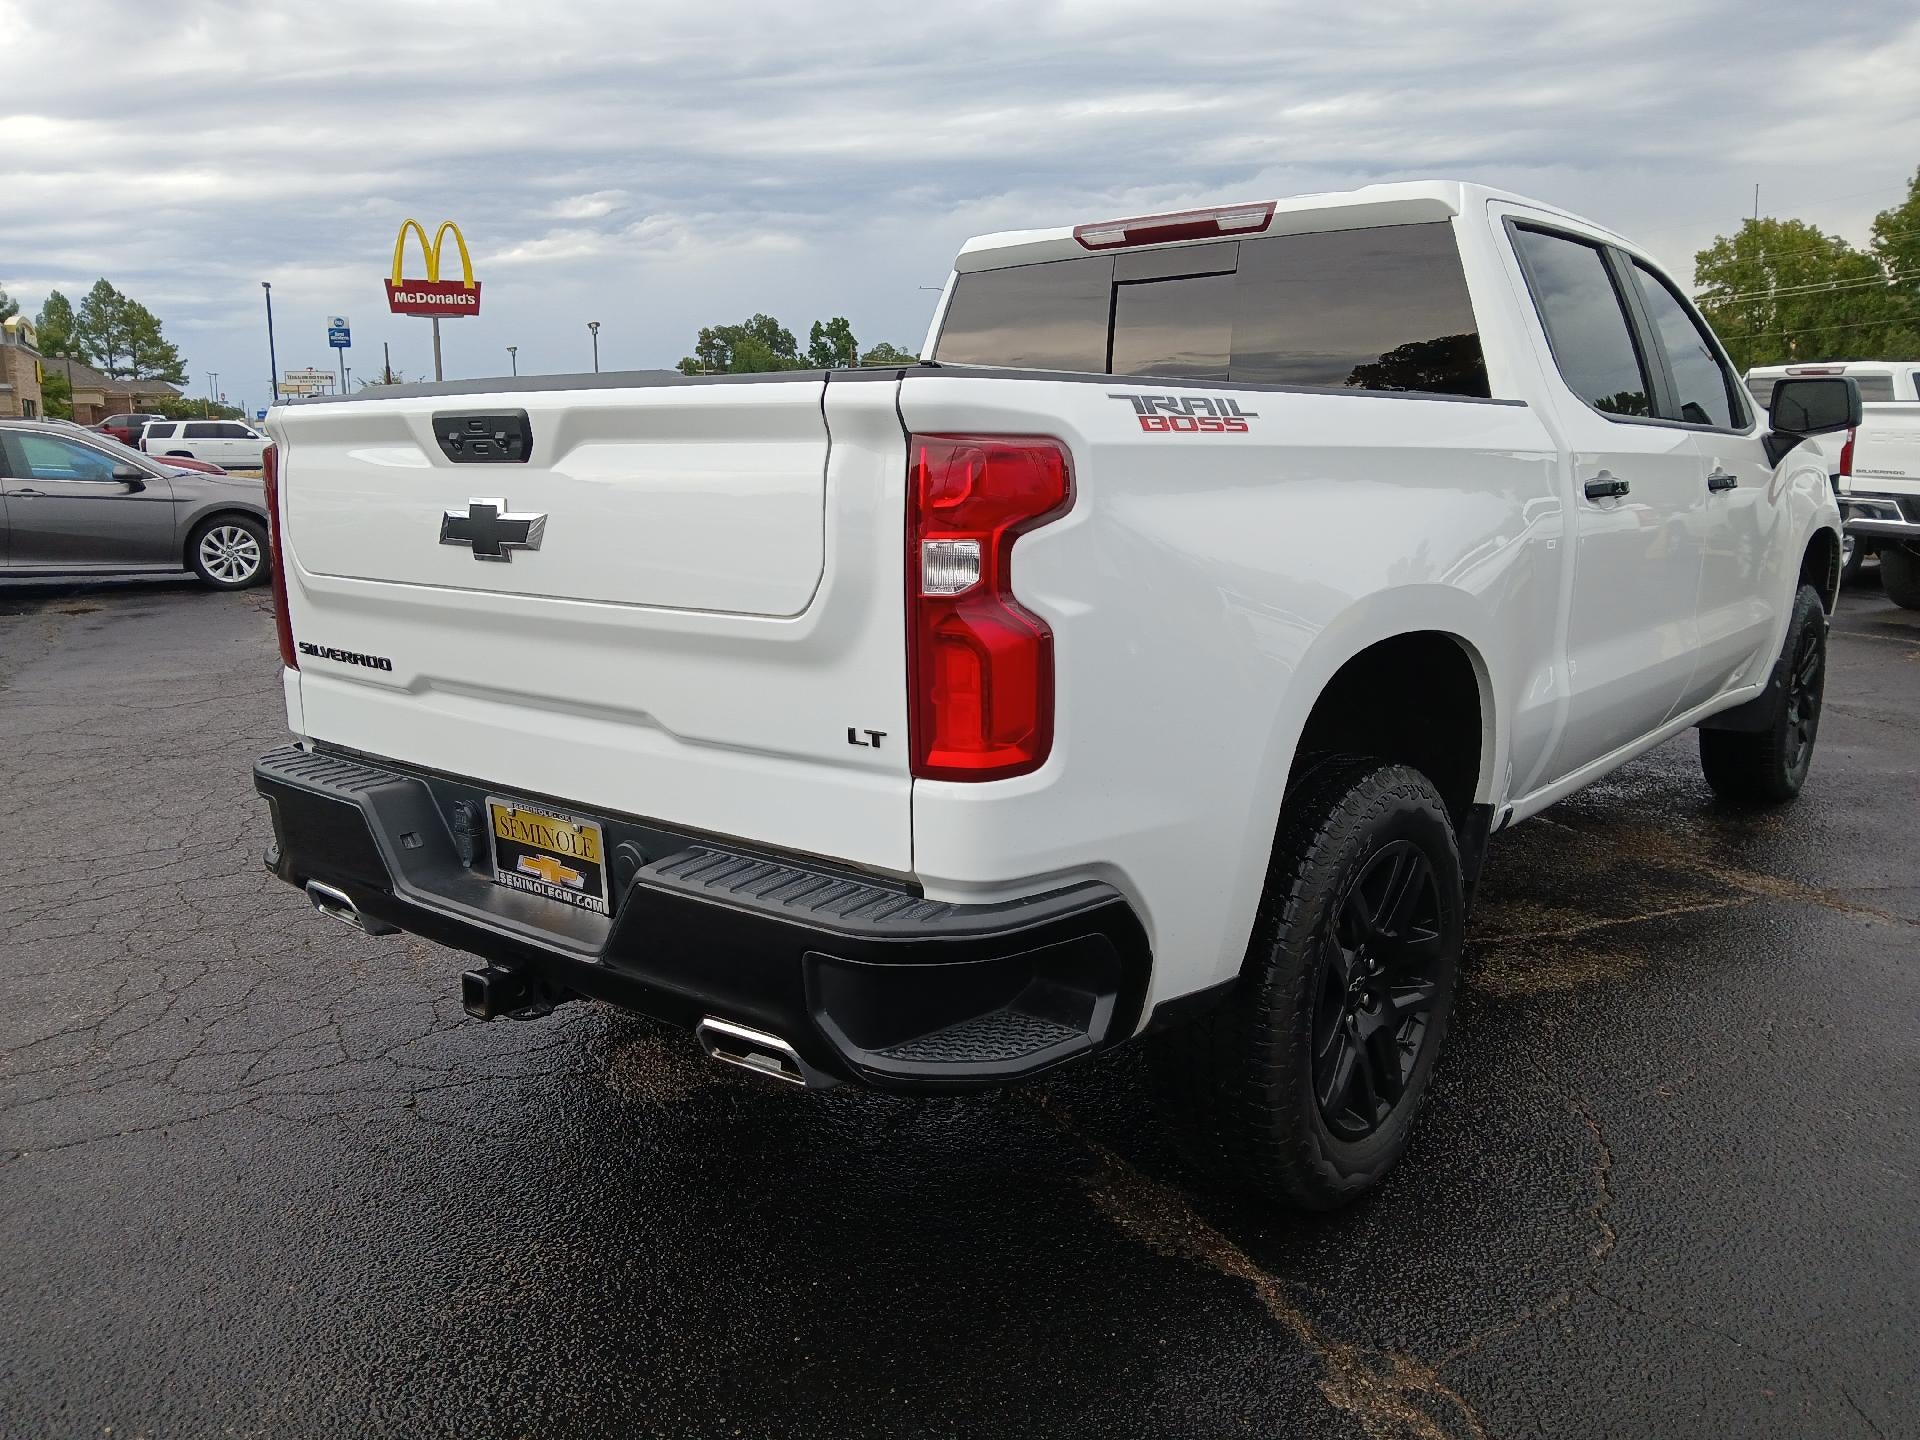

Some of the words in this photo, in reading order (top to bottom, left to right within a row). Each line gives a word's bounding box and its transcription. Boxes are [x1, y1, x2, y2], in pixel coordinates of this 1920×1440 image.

[394, 291, 476, 305] McDonald's
[1108, 394, 1259, 417] TRAIL
[1138, 415, 1249, 432] BOSS
[299, 641, 392, 672] SILVERADO
[847, 726, 887, 748] LT
[500, 815, 595, 859] SEMINOLE
[499, 872, 604, 914] SEMINOLEGM.COM
